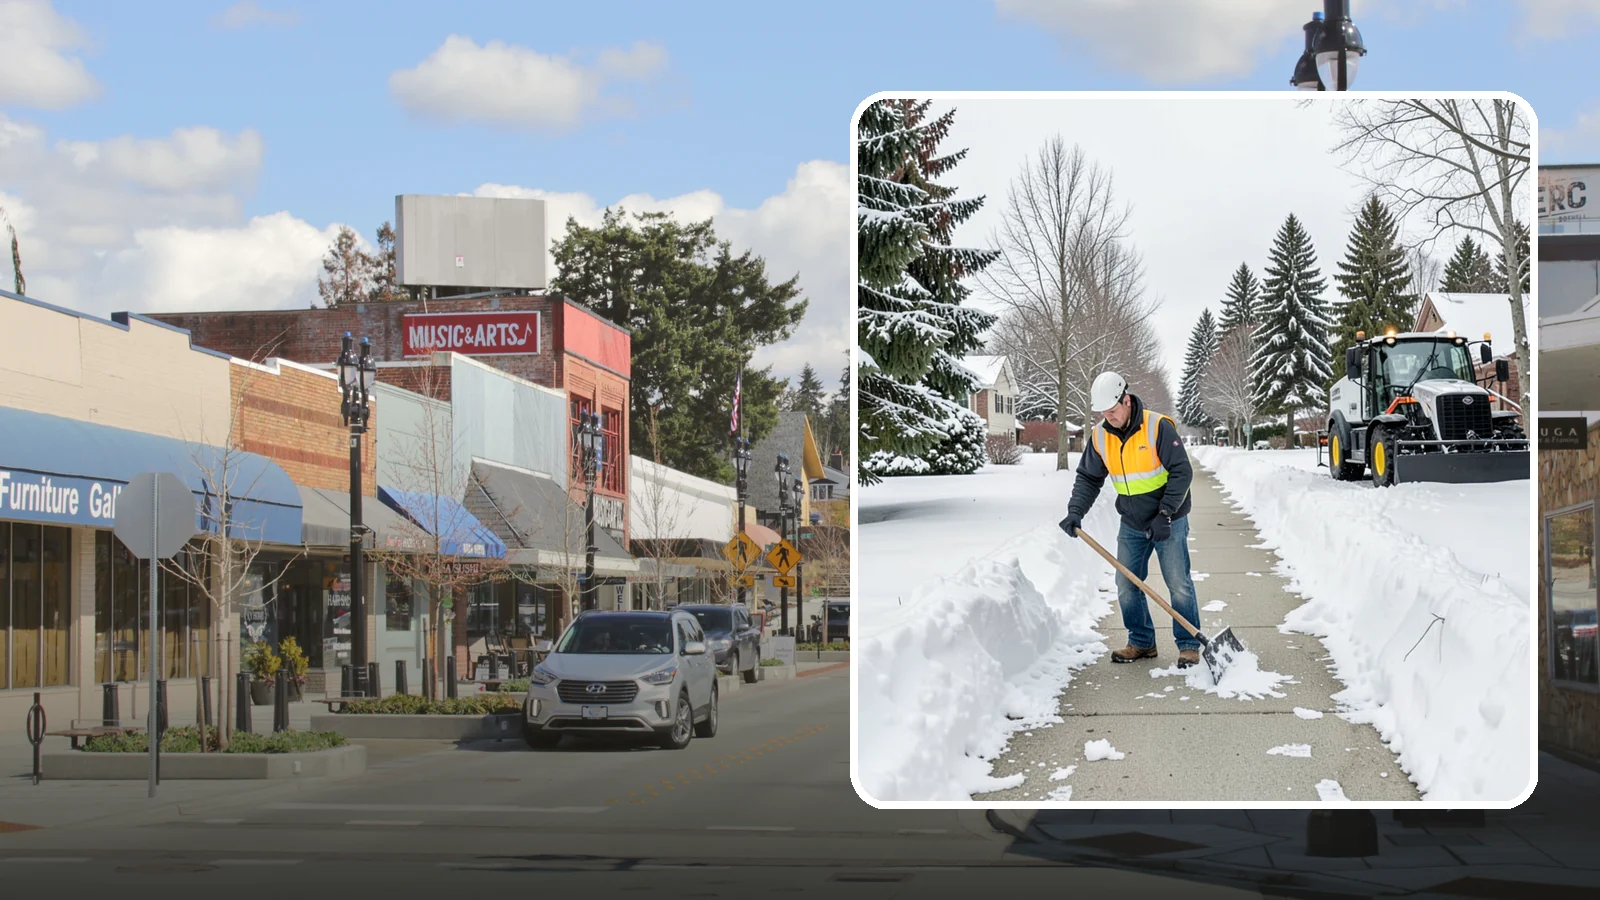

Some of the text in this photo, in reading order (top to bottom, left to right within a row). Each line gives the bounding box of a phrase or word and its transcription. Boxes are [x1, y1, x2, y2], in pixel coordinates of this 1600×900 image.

[1540, 427, 1578, 437] UGA
[0, 471, 122, 519] Furniture Gal
[453, 563, 480, 574] SUSHI
